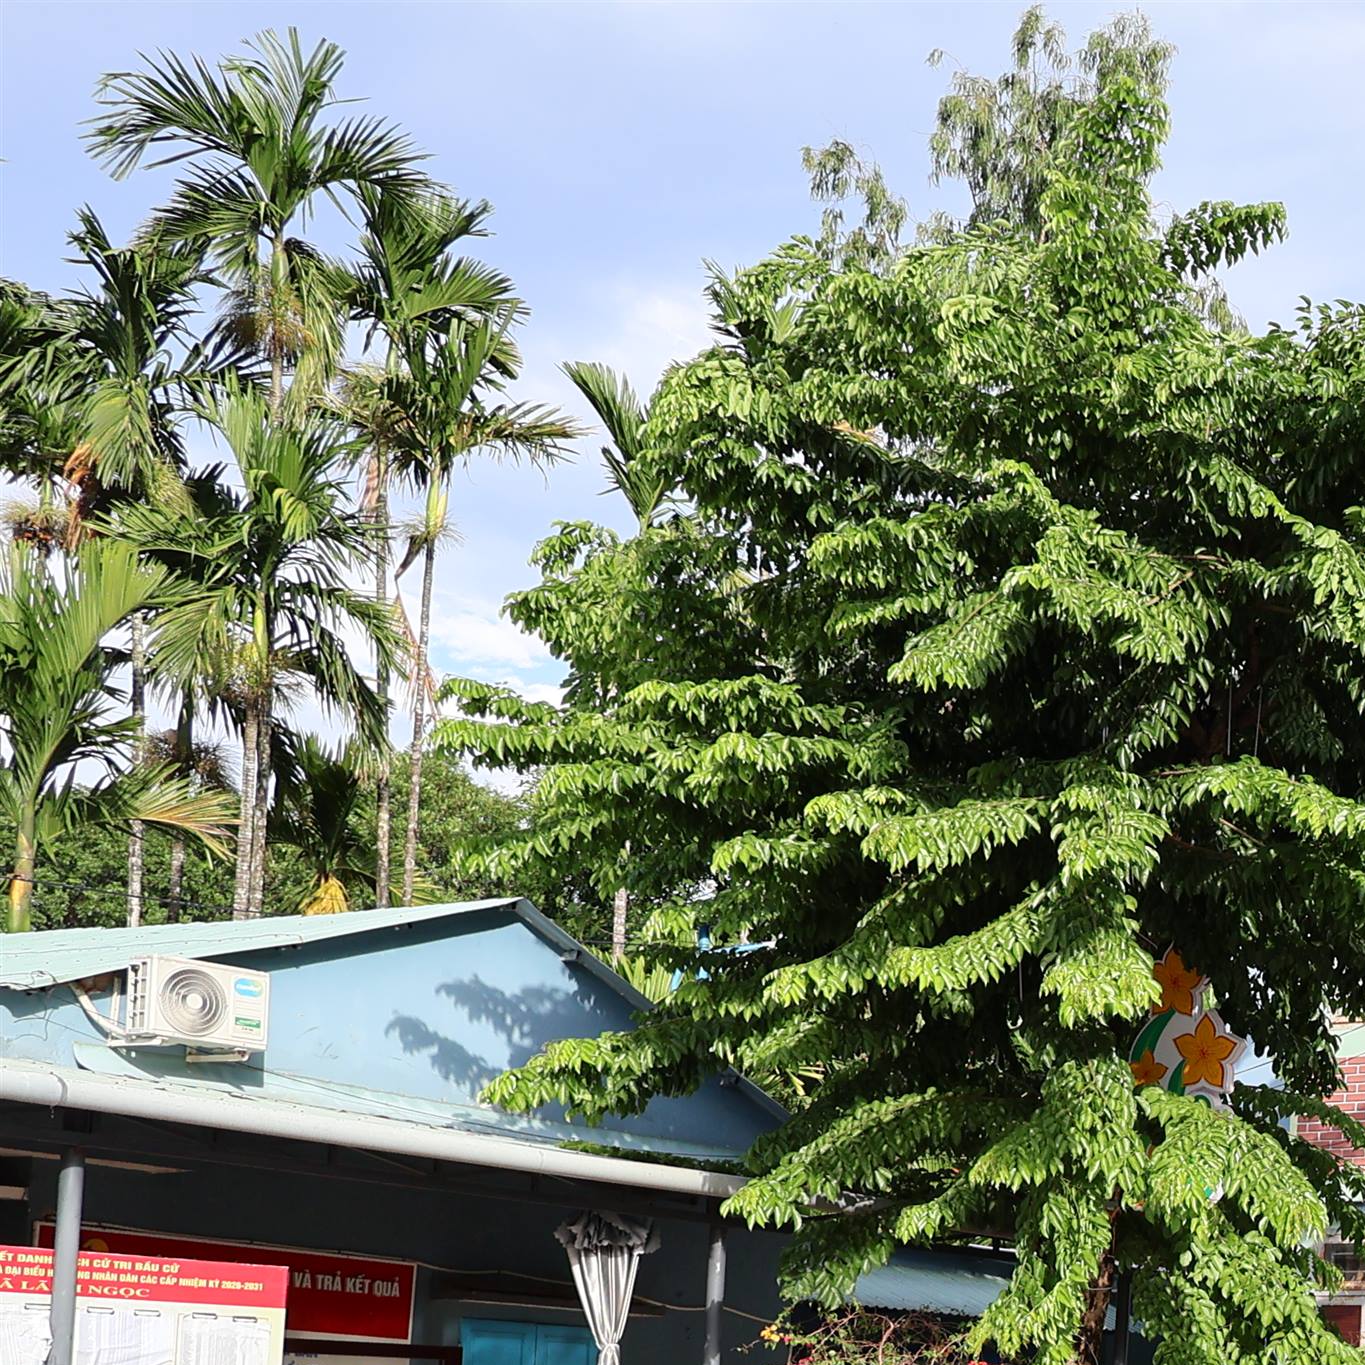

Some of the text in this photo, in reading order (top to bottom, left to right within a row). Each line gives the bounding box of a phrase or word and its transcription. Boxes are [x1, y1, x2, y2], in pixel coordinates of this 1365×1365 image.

[0, 1250, 14, 1261] ẾT
[17, 1254, 53, 1264] DANH
[113, 1261, 132, 1270] TRI
[77, 1271, 91, 1279] NG
[294, 1269, 311, 1289] VÀ
[316, 1270, 342, 1291] TRẢ
[345, 1274, 371, 1295] KẾT
[0, 1277, 14, 1289] Ã
[88, 1285, 150, 1299] NGỌC
